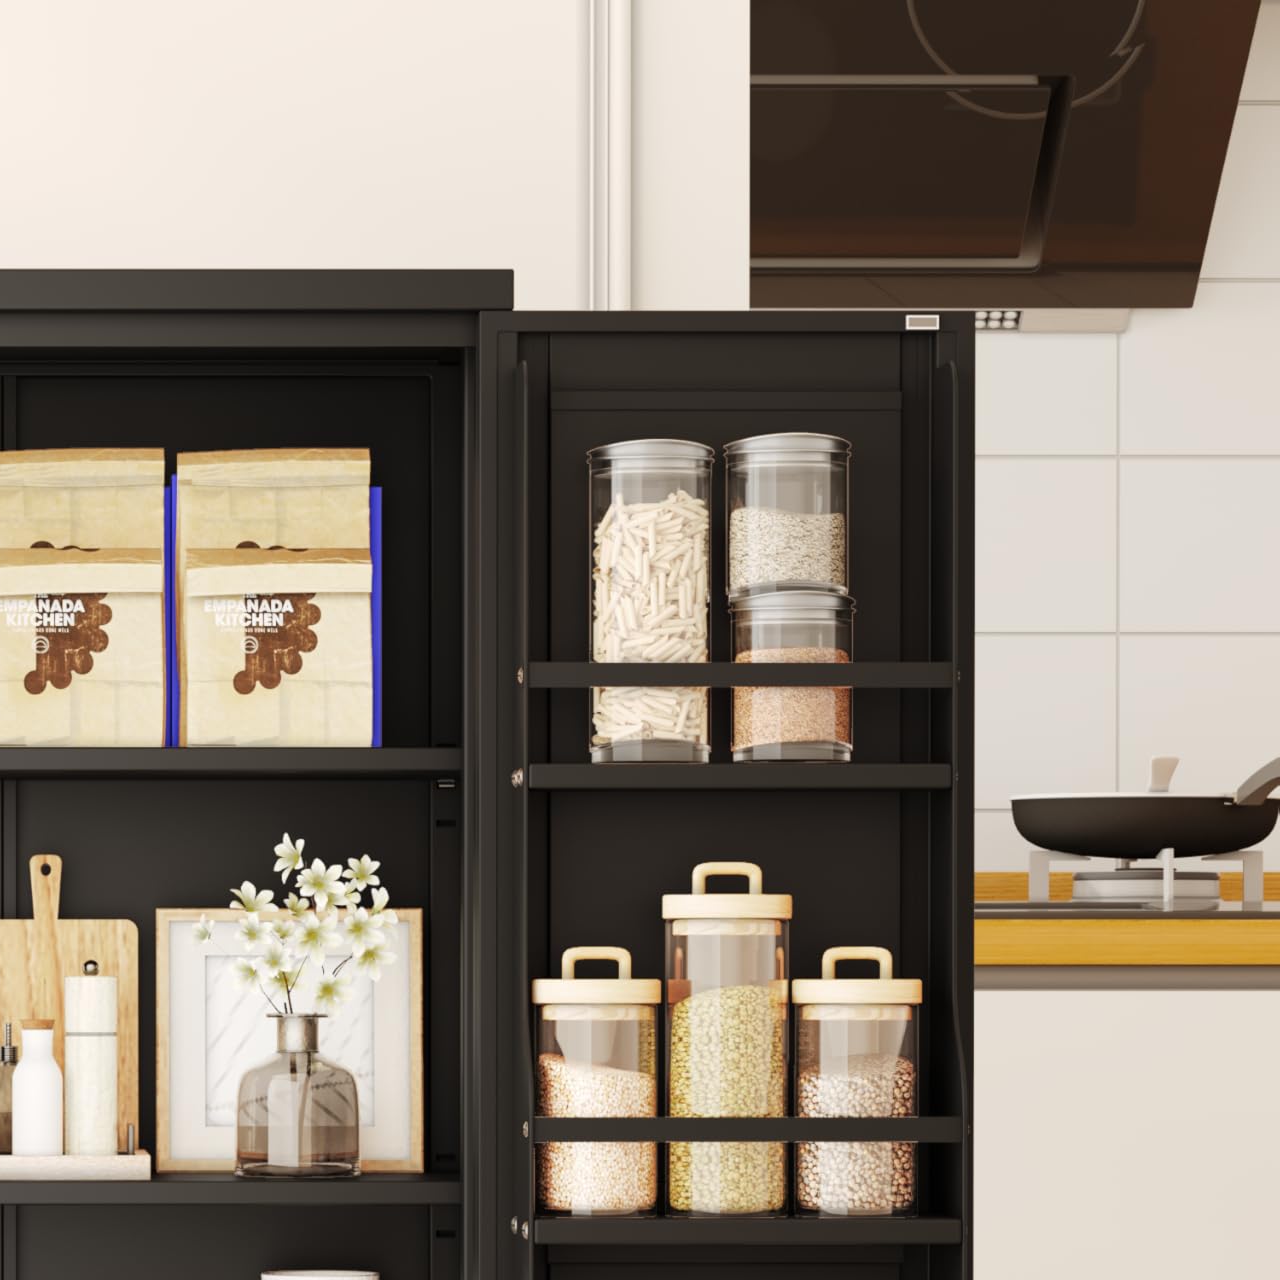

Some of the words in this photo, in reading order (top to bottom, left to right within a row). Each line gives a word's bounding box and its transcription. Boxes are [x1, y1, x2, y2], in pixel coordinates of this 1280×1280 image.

[203, 599, 294, 613] EMPANADA
[6, 612, 75, 627] KITCHEN
[215, 612, 284, 627] KITCHEN
